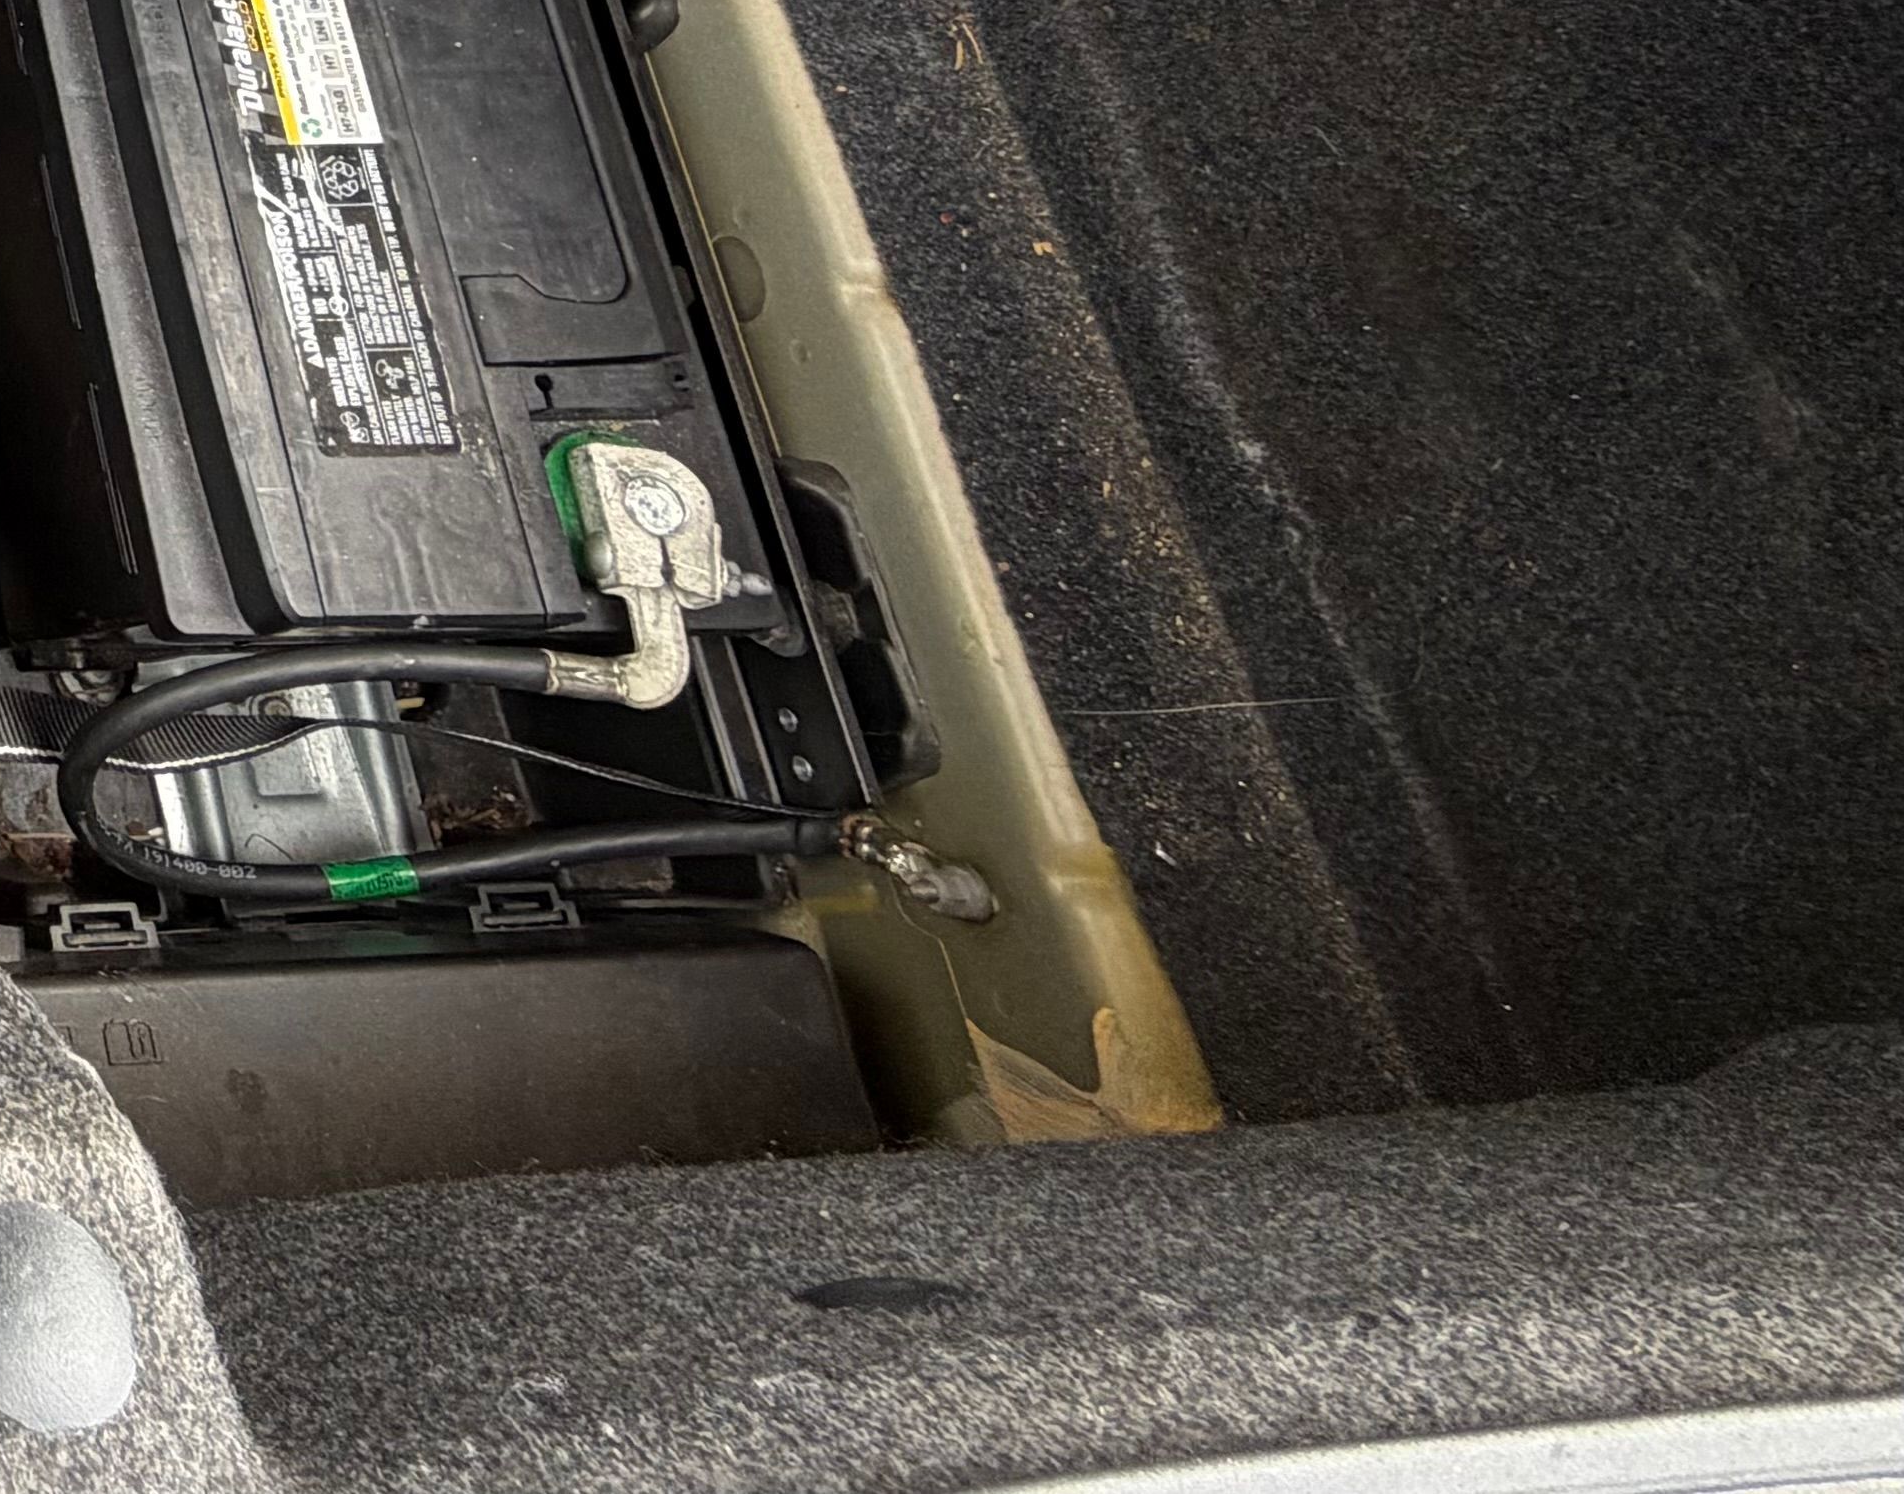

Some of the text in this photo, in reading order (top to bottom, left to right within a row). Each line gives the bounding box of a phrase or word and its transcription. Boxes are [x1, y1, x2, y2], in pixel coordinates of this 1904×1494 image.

[237, 0, 259, 51] GOLD
[322, 53, 337, 69] H7
[144, 846, 257, 880] 191400-002
